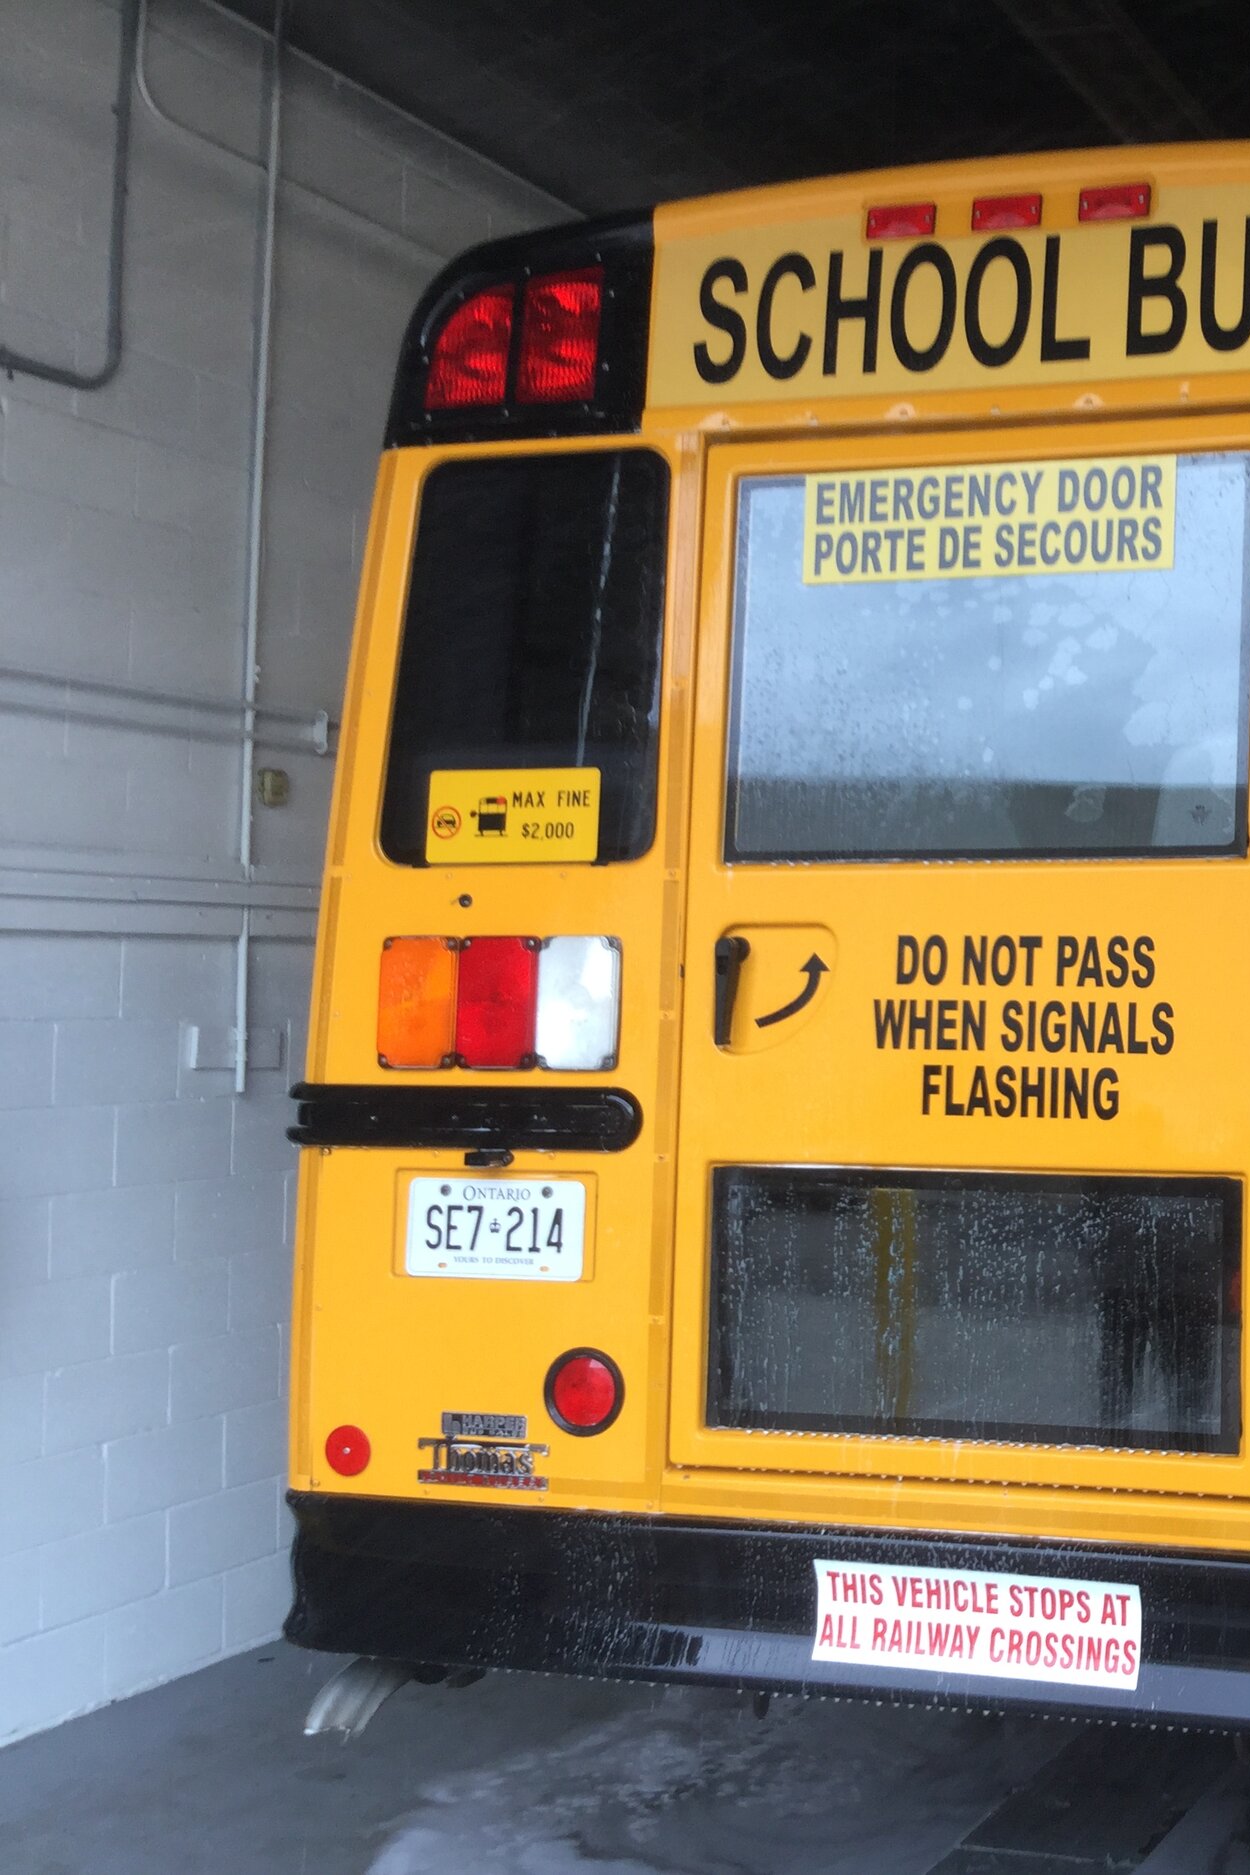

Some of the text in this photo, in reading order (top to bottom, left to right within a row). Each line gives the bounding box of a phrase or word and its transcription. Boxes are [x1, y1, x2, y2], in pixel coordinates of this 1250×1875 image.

[692, 235, 1091, 384] SCHOOL
[815, 465, 1163, 525] EMERGENCY DOOR
[813, 517, 1163, 576] PORTE DE SECOURS
[512, 789, 591, 808] MAX FINE
[896, 934, 1155, 988] DO NOT PASS
[873, 999, 1174, 1055] WHEN SIGNALS
[922, 1064, 1119, 1120] FLASHING
[463, 1185, 531, 1201] ONTARIO
[425, 1204, 563, 1253] SE7 214
[482, 1256, 493, 1264] TO
[495, 1257, 534, 1265] DISCOVER
[462, 1415, 525, 1430] HARPER
[418, 1437, 549, 1475] Thomas
[826, 1570, 1131, 1627] THIS VEHICLE STOPS AT
[818, 1613, 1137, 1676] ALL RAILWAY CROSSINGS
